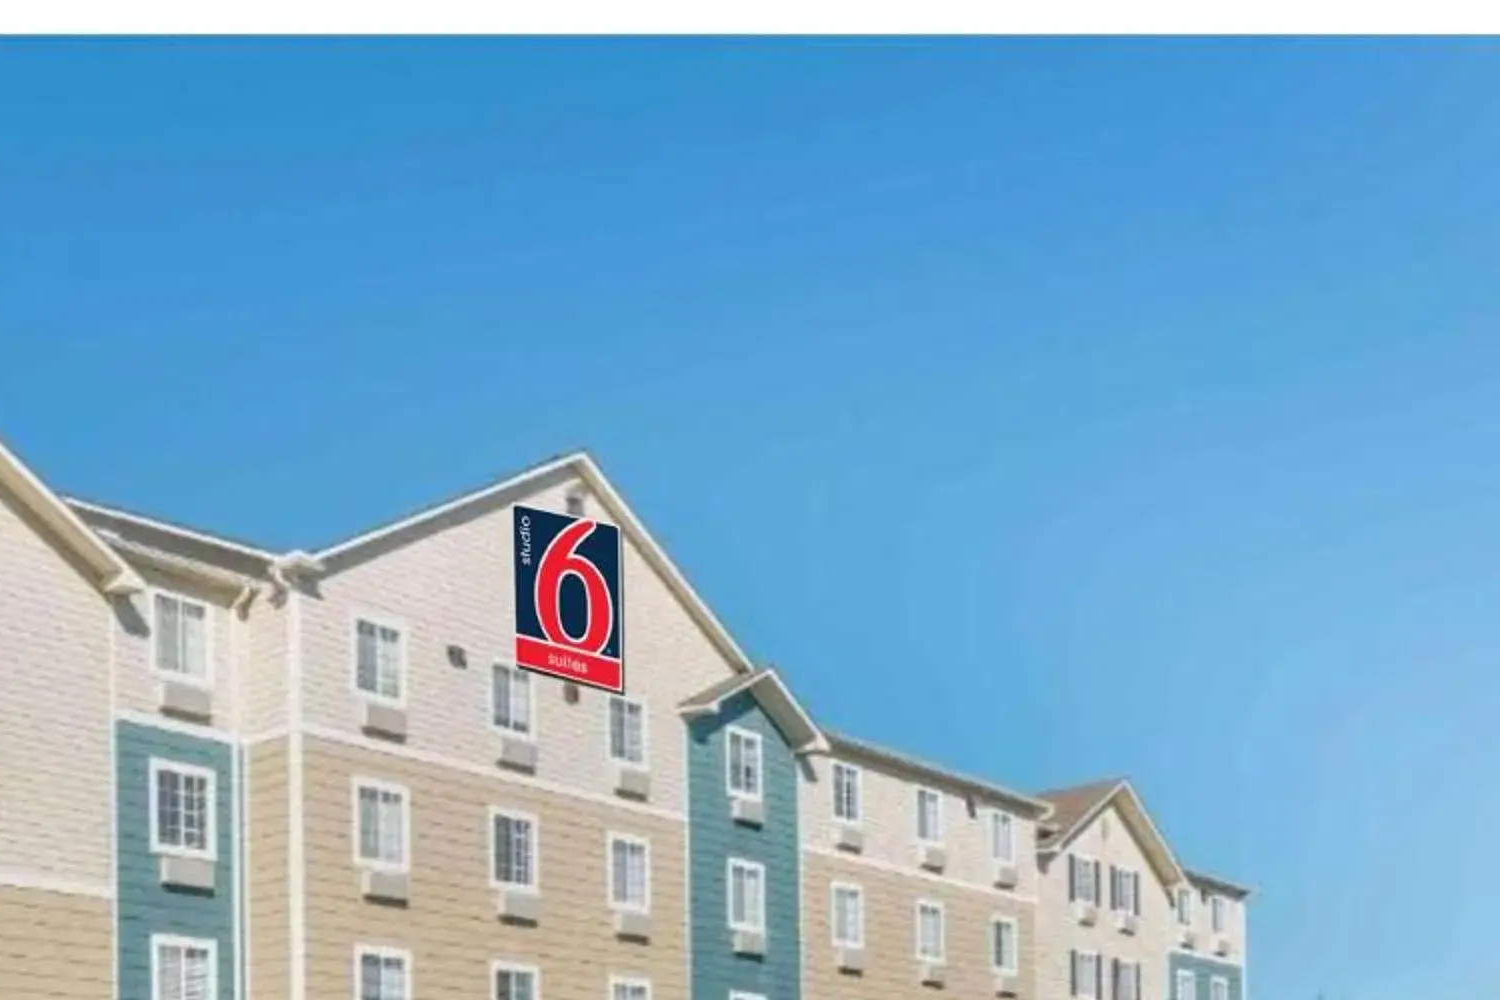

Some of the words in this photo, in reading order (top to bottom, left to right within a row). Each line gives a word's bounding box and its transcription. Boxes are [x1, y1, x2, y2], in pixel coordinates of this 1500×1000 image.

[520, 515, 532, 566] studio
[534, 518, 613, 655] 6
[548, 654, 588, 673] suites
